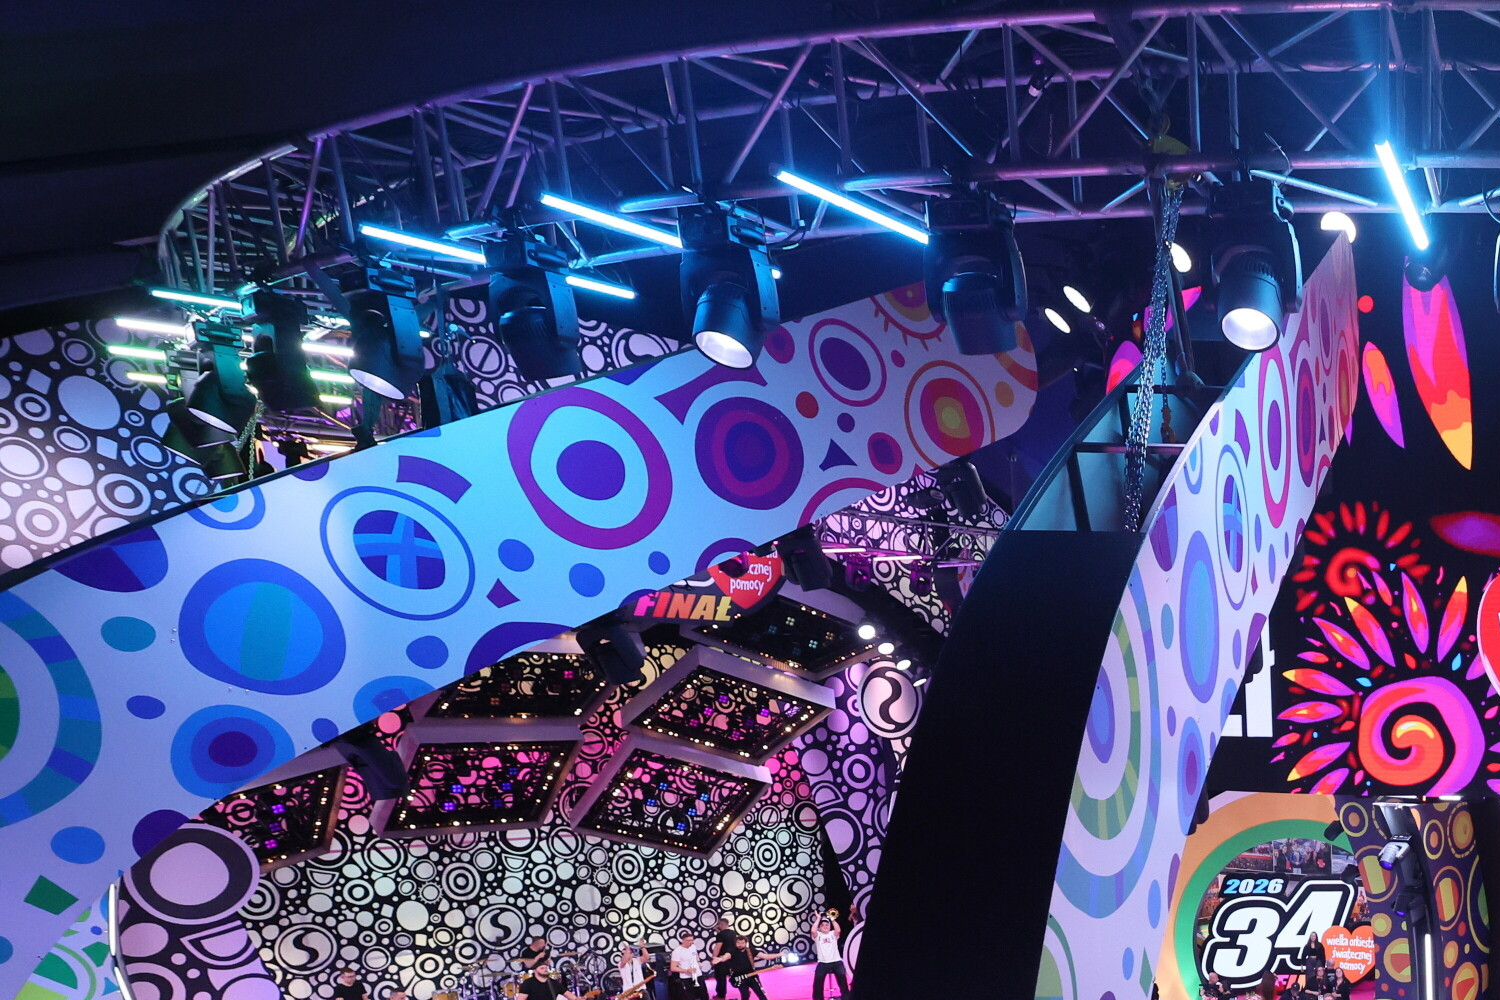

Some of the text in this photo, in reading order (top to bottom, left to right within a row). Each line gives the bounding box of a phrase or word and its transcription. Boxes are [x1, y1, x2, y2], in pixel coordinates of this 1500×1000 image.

[730, 578, 764, 596] pomocy
[1224, 878, 1285, 894] 2026
[1209, 888, 1347, 981] 34
[1326, 933, 1349, 946] wielka
